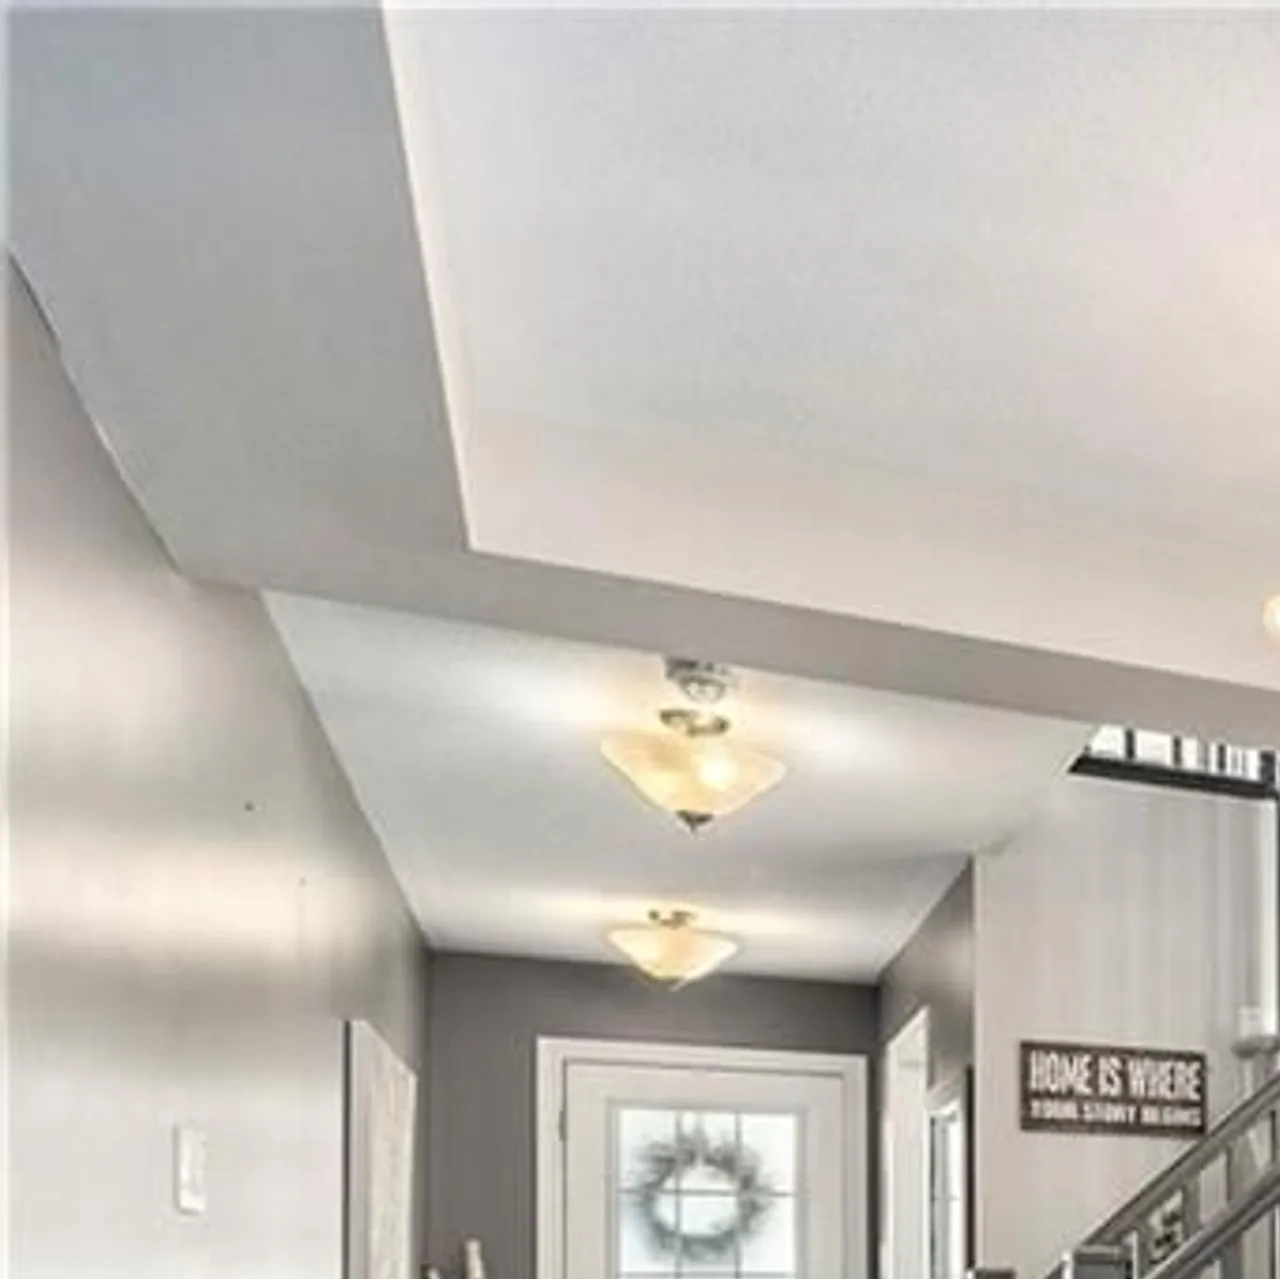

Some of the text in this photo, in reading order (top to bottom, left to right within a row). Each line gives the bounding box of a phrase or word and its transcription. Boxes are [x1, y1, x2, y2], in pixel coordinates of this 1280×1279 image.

[1030, 1050, 1201, 1101] HOME IS WHERE
